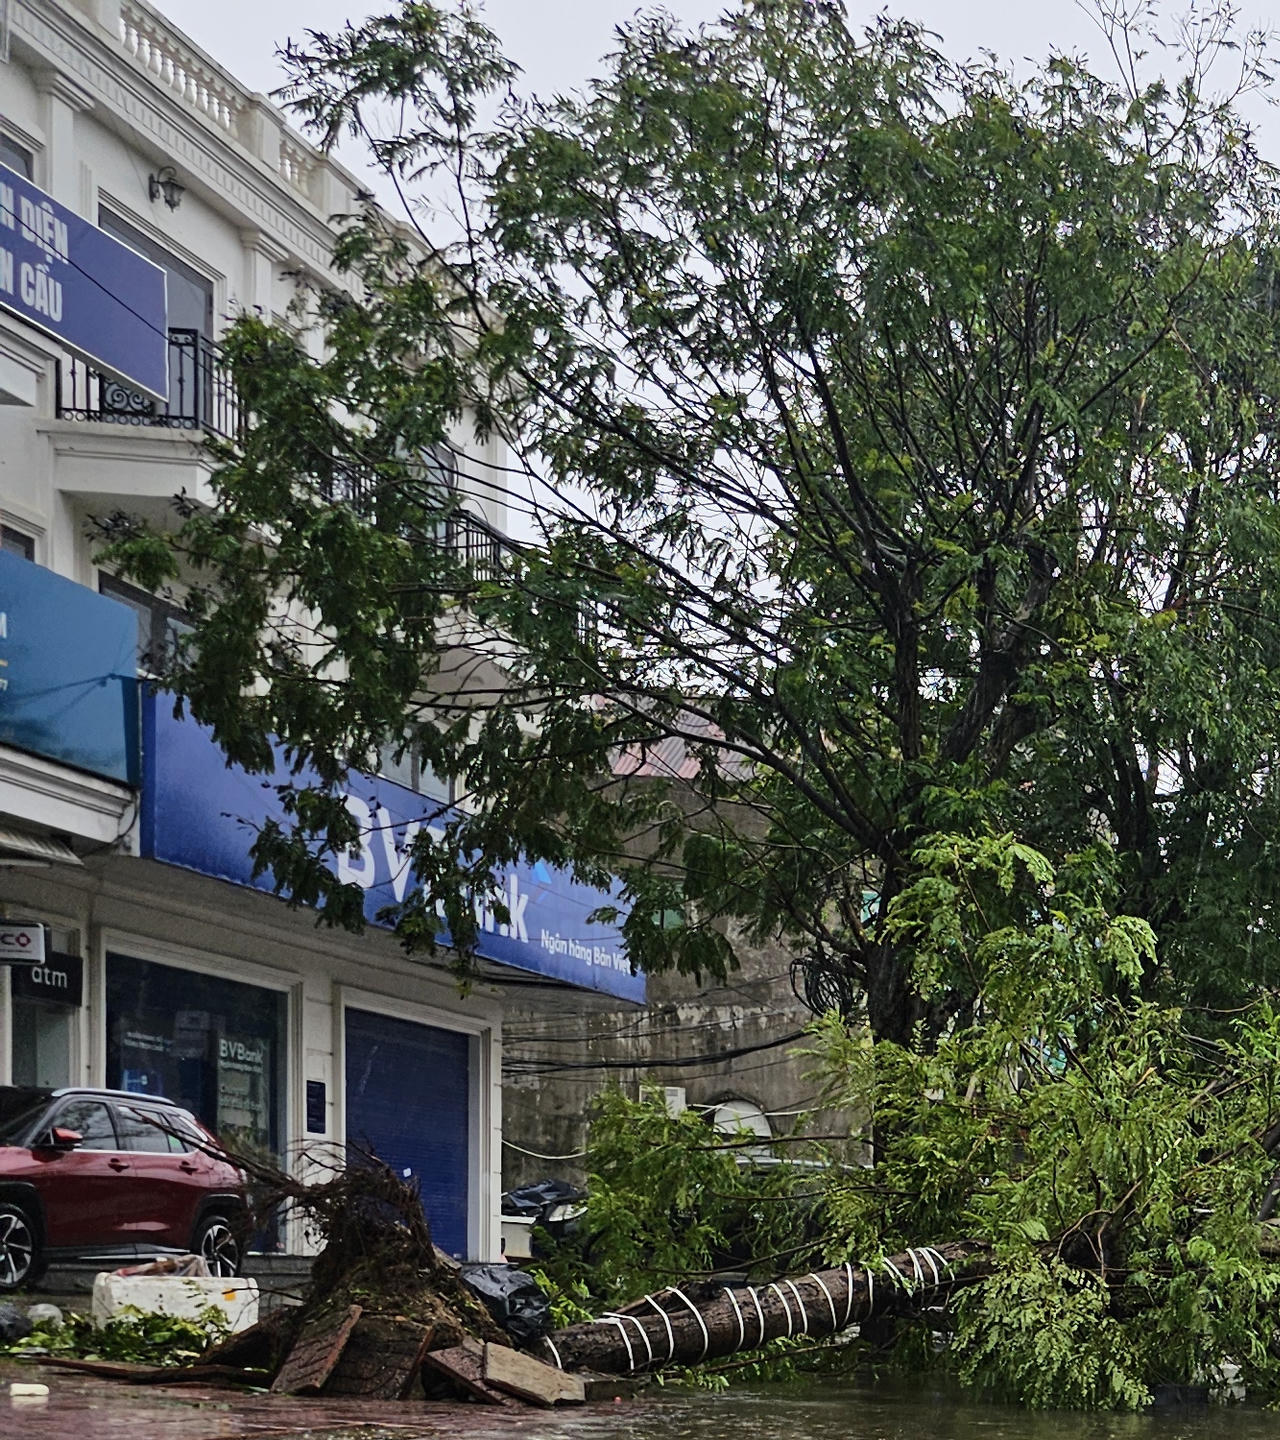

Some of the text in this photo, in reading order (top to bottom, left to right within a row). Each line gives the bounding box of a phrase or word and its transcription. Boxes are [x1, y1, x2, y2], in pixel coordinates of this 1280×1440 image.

[20, 262, 62, 322] CẦU
[541, 928, 567, 955] Ngân
[568, 939, 592, 966] hàng
[594, 946, 612, 968] Bản
[32, 966, 67, 989] atm
[219, 1038, 263, 1063] BVBank
